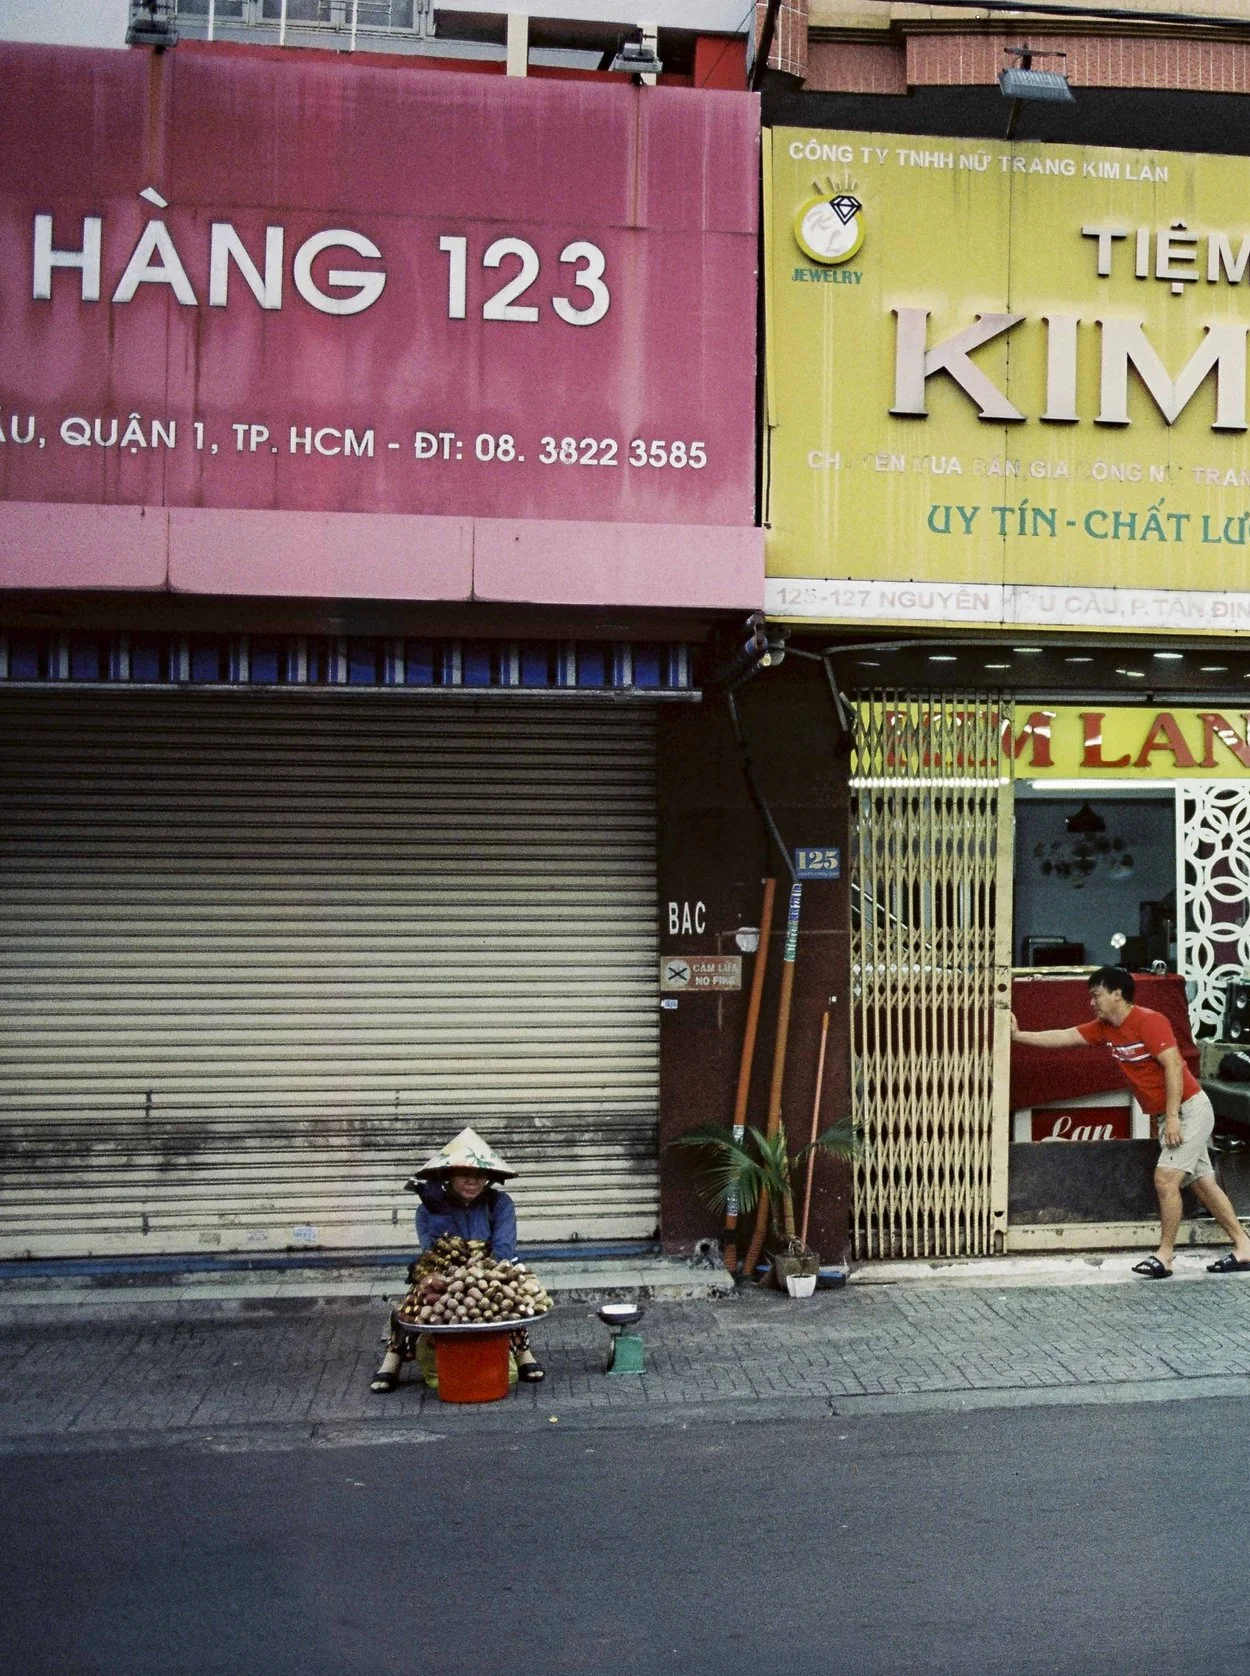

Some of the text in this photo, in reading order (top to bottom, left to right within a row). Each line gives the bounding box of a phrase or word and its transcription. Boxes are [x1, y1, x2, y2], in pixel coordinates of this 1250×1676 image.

[790, 138, 853, 163] CÔNG
[860, 147, 888, 166] TY
[897, 149, 953, 170] TNHH
[999, 155, 1075, 177] TRANG
[1083, 161, 1120, 180] KIM
[1126, 163, 1169, 183] LAN
[33, 187, 611, 326] HÀNG 123
[792, 268, 863, 285] JEWELRY
[888, 306, 1250, 431] KIM
[0, 405, 46, 448] U,
[60, 412, 177, 454] QUẬN
[195, 422, 218, 454] 1,
[233, 424, 278, 453] TP.
[290, 426, 374, 457] HCM
[415, 432, 463, 460] ĐT:
[475, 434, 524, 462] 08.
[539, 436, 618, 466] 3822
[629, 440, 707, 469] 3585
[1030, 460, 1070, 479] GIA
[927, 504, 980, 535] UY
[992, 498, 1057, 538] TÍN
[1084, 498, 1190, 543] CHẤT
[798, 851, 838, 869] 125
[668, 901, 706, 935] BAC
[695, 976, 710, 986] NO
[1040, 1116, 1117, 1141] Lan
